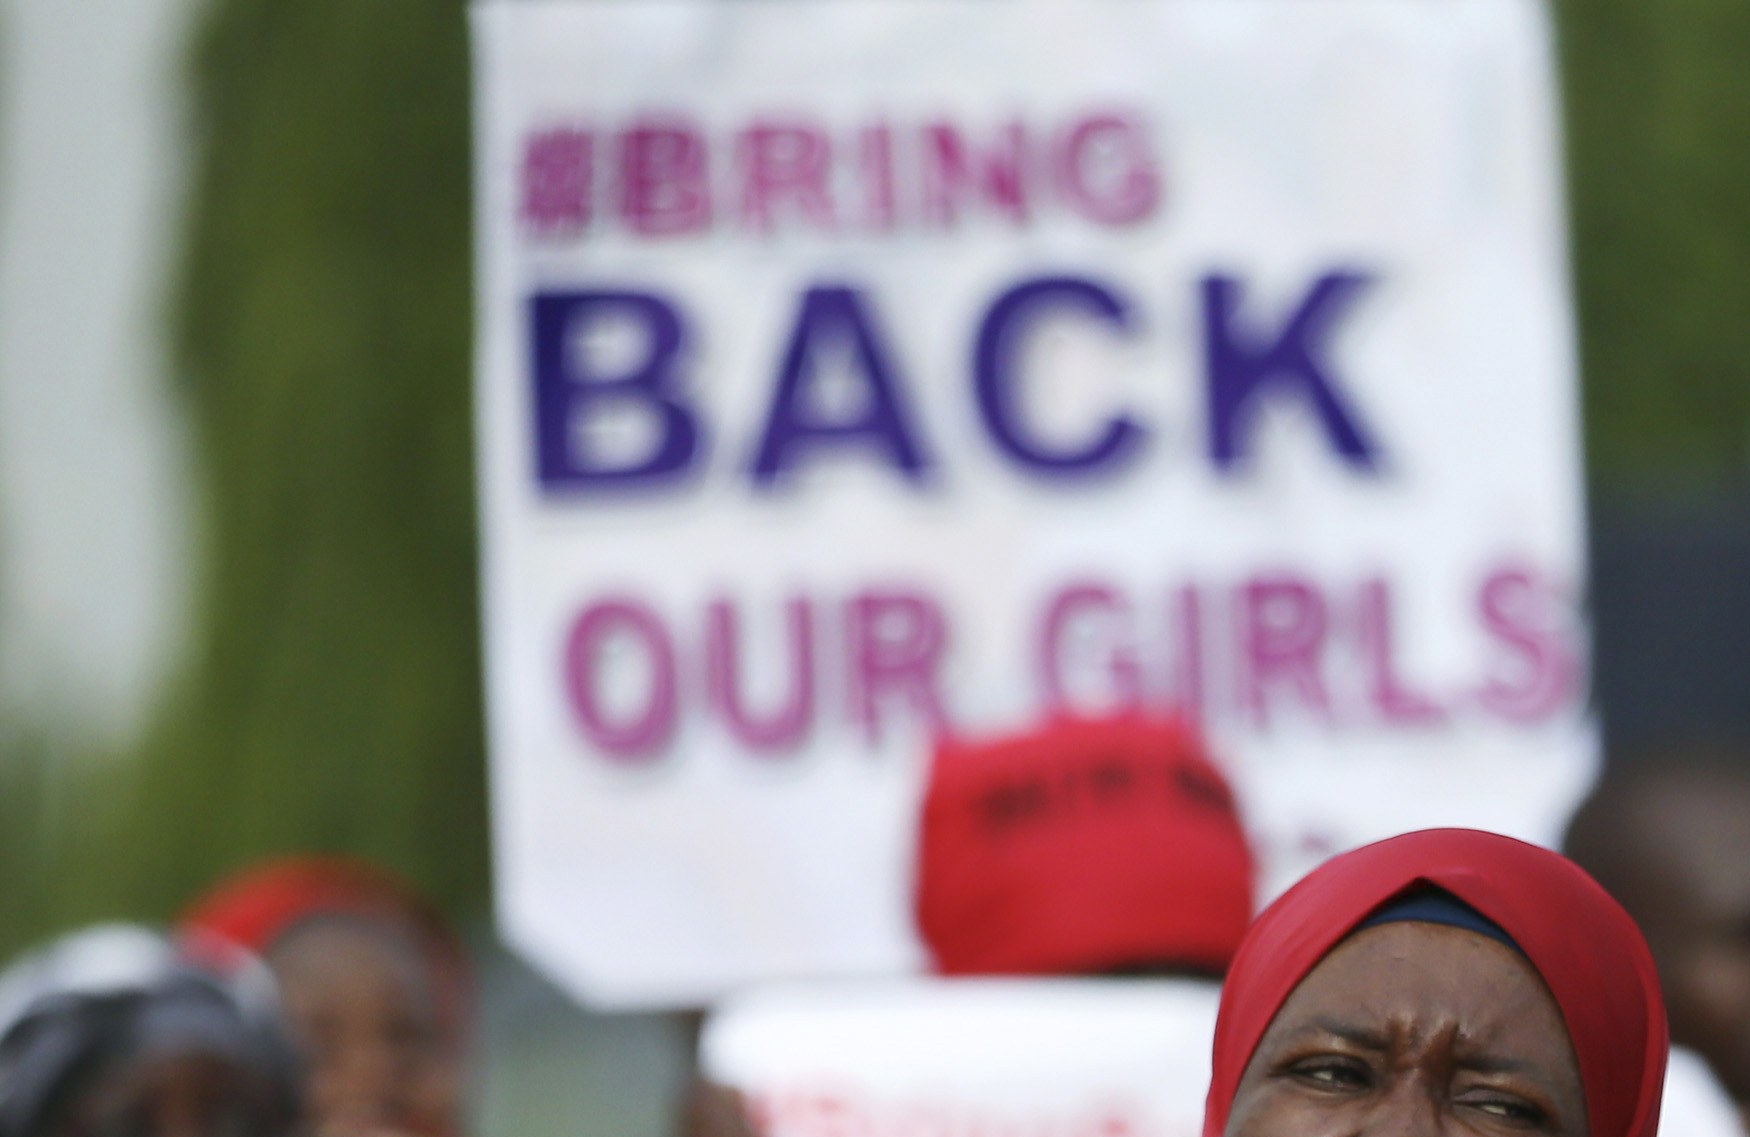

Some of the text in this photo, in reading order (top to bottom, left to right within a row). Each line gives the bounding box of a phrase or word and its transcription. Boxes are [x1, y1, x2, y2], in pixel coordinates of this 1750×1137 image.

[517, 112, 1164, 240] #BRING
[525, 268, 1392, 502] BACK
[558, 562, 1580, 762] OUR GIRLS
